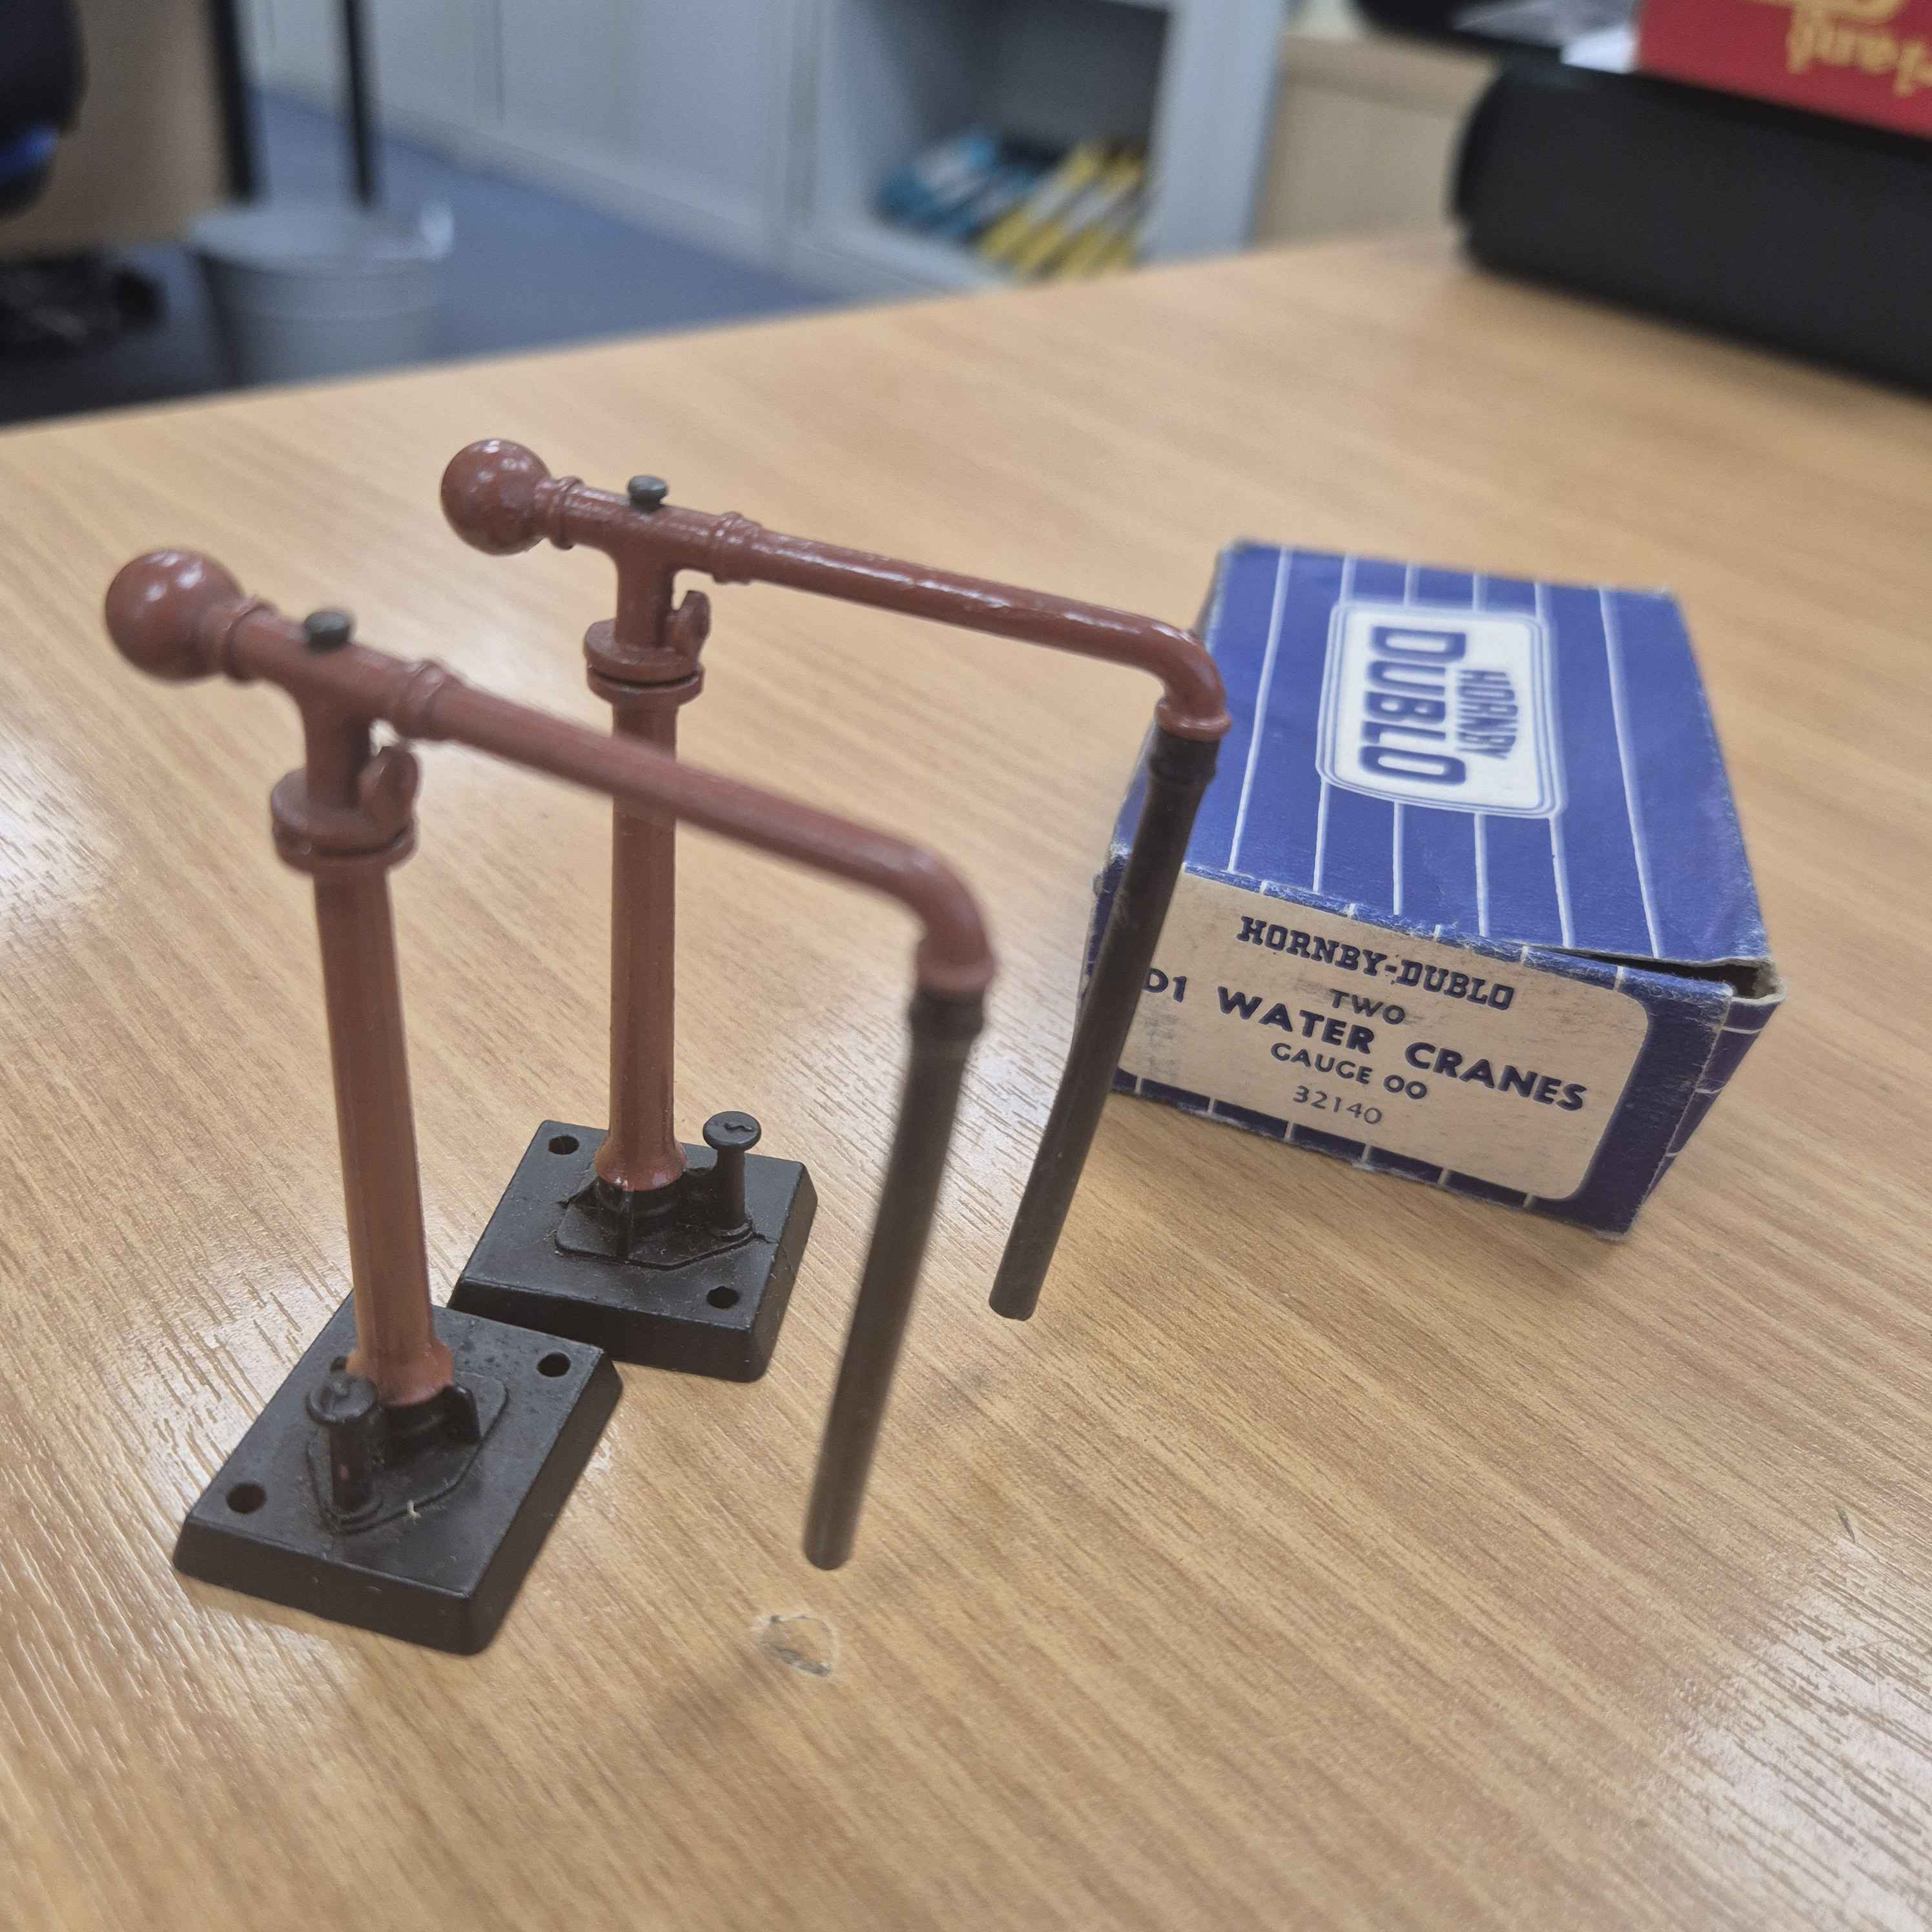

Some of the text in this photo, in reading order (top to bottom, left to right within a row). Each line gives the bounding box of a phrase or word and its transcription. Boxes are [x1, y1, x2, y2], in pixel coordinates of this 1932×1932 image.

[1359, 625, 1468, 786] DUBLO
[1456, 668, 1519, 760] HORNBY
[1236, 916, 1516, 1011] HORNBY-DUBLO
[1328, 988, 1408, 1025] TWO
[1217, 985, 1375, 1054] WATER
[1404, 1042, 1588, 1111] CRANES
[1270, 1042, 1373, 1085] GAUGE
[1293, 1085, 1382, 1125] 32140
